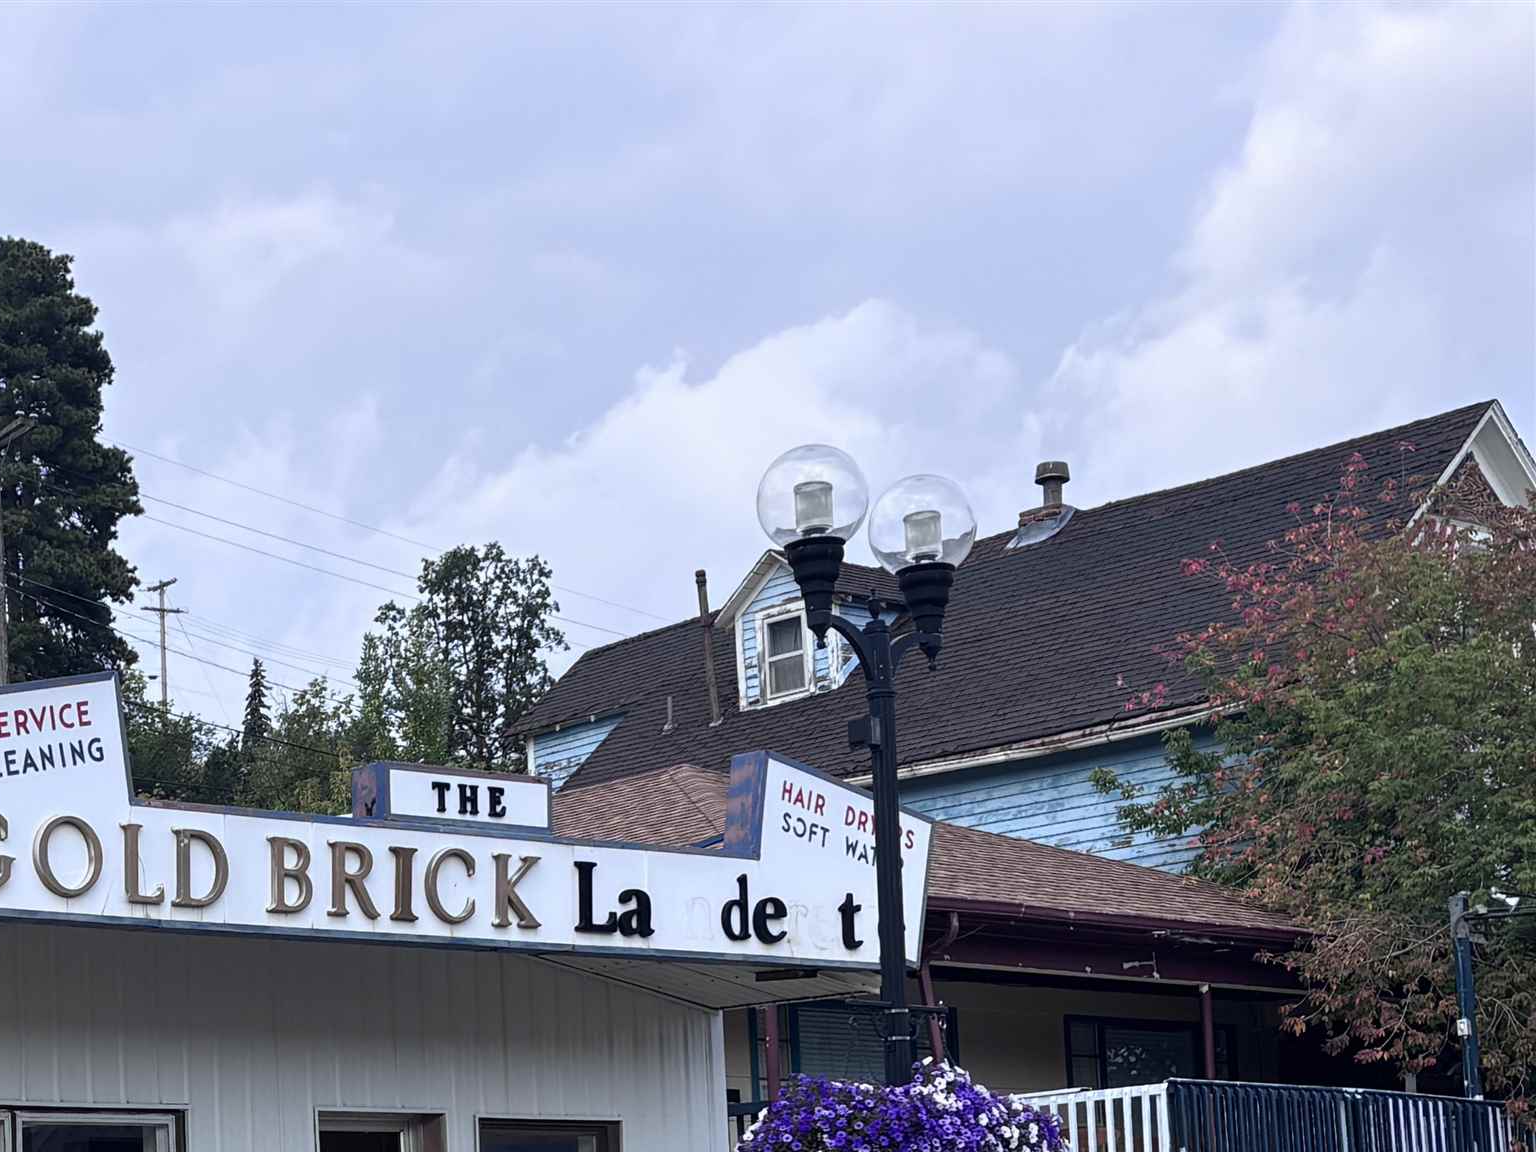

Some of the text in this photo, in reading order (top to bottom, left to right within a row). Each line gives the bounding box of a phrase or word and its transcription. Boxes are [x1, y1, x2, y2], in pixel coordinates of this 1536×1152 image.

[431, 781, 507, 818] THE
[781, 780, 914, 849] HAIR DRYS
[782, 812, 830, 847] SOFT
[266, 836, 542, 929] BRICK
